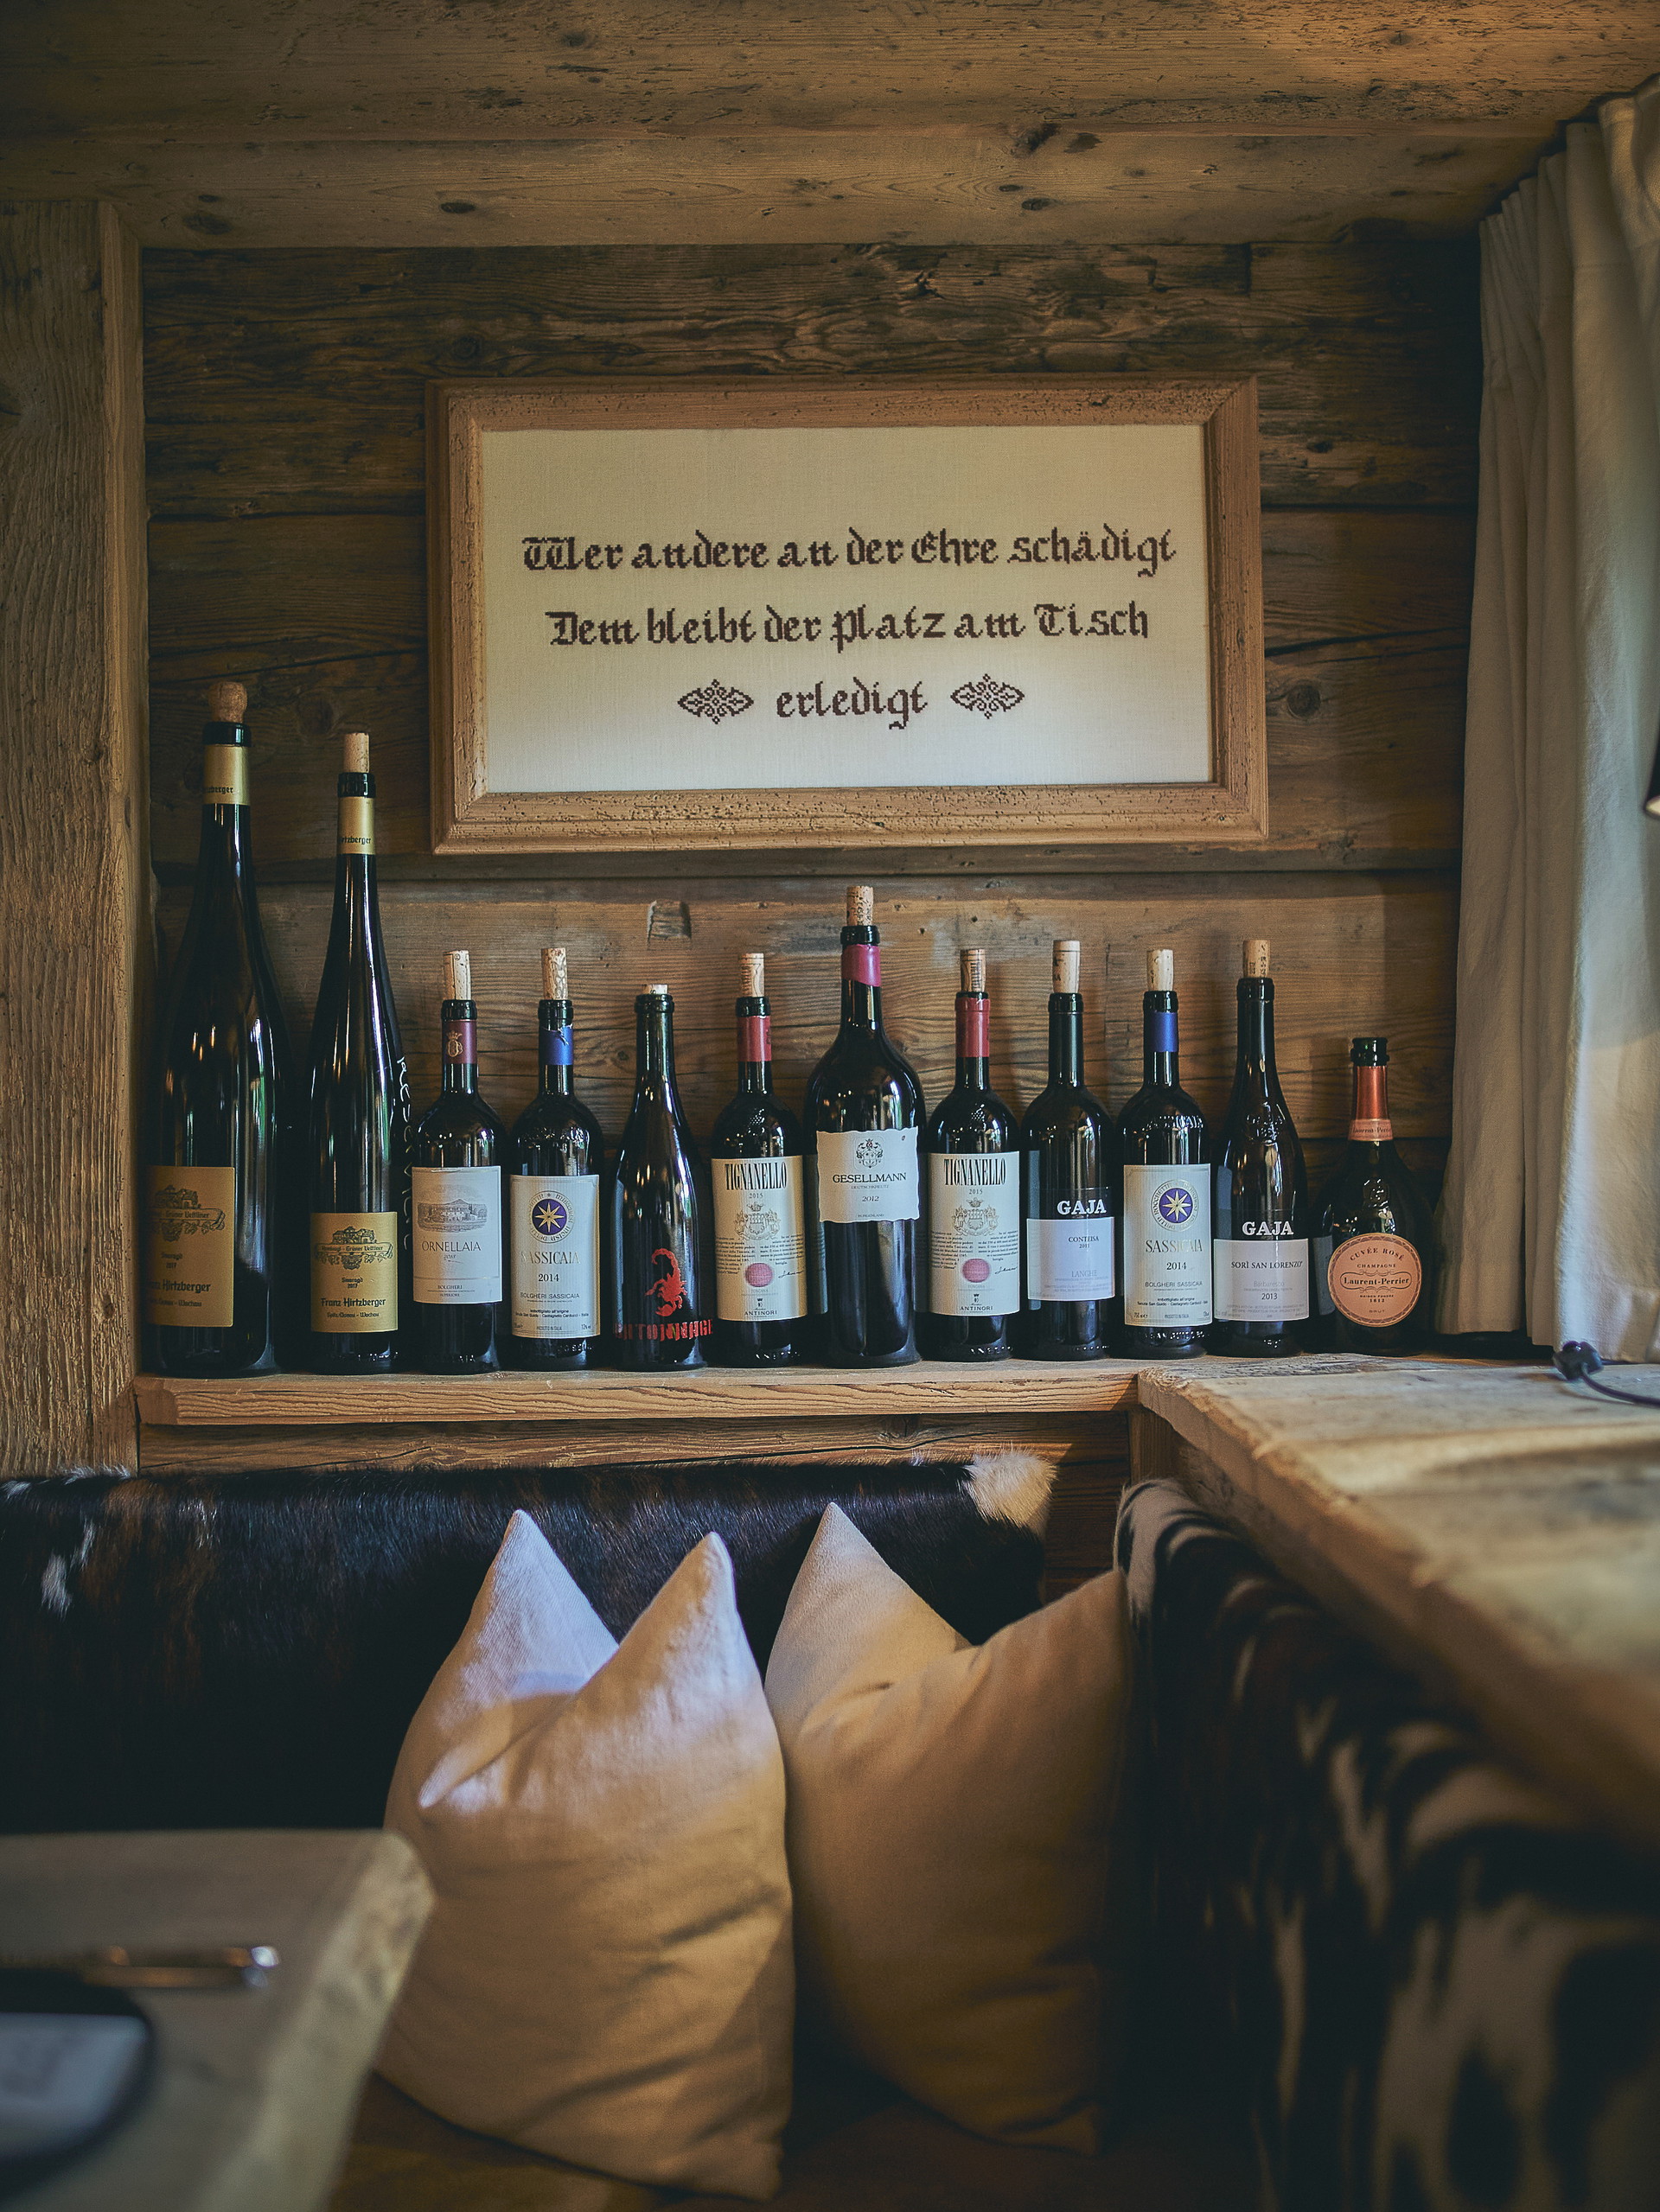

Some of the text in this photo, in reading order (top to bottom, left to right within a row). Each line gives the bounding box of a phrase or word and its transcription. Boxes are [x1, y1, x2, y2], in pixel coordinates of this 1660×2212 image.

[521, 523, 1177, 577] Wer andere an der Ehre schädigt
[545, 611, 640, 645] Dem
[647, 606, 757, 644] bleibt
[764, 604, 821, 642] der
[954, 612, 1025, 639] am
[1034, 600, 1149, 639] Tisch
[776, 676, 929, 730] erledigt
[724, 1161, 787, 1190] TIGNANELLO
[833, 1172, 907, 1183] GESELLMANN
[943, 1157, 1006, 1187] TIGNANELLO
[1057, 1199, 1108, 1215] GAJA
[1242, 1221, 1294, 1236] GAJA
[421, 1240, 482, 1253] ORNELLAIA
[1146, 1239, 1203, 1253] SASSICAIA
[520, 1251, 581, 1265] SASSICAIA
[1350, 1246, 1405, 1261] CUVÉE ROSÉ
[1166, 1261, 1187, 1271] 2014
[1231, 1260, 1249, 1269] SORÌ
[538, 1273, 559, 1282] 2014
[1071, 1269, 1098, 1278] LANGHE
[163, 1279, 211, 1293] Hirtzberger
[1344, 1277, 1409, 1285] Laurent-Perrier
[321, 1297, 386, 1308] Franz Hirtzberger
